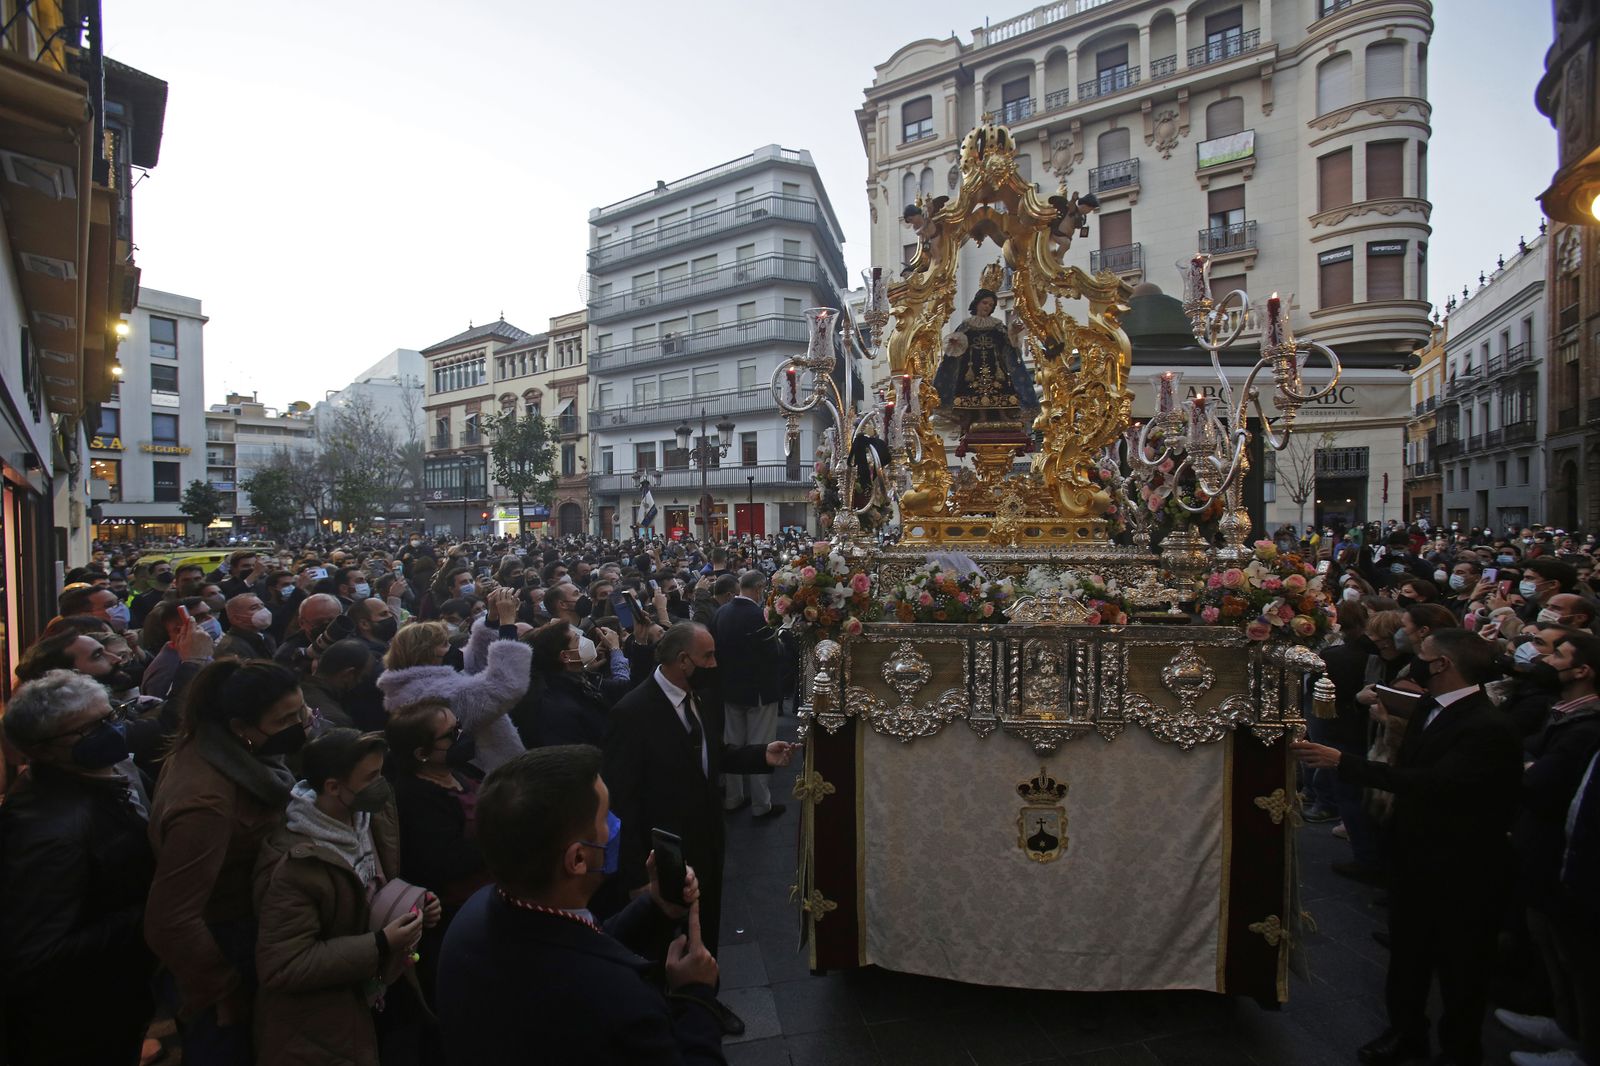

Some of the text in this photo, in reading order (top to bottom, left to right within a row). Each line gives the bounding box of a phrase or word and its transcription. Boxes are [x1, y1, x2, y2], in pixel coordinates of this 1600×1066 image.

[1320, 249, 1352, 261] HIPOTECAS
[1371, 244, 1402, 252] HIPOTECAS
[1186, 385, 1234, 405] ABC
[1305, 386, 1355, 405] ABC
